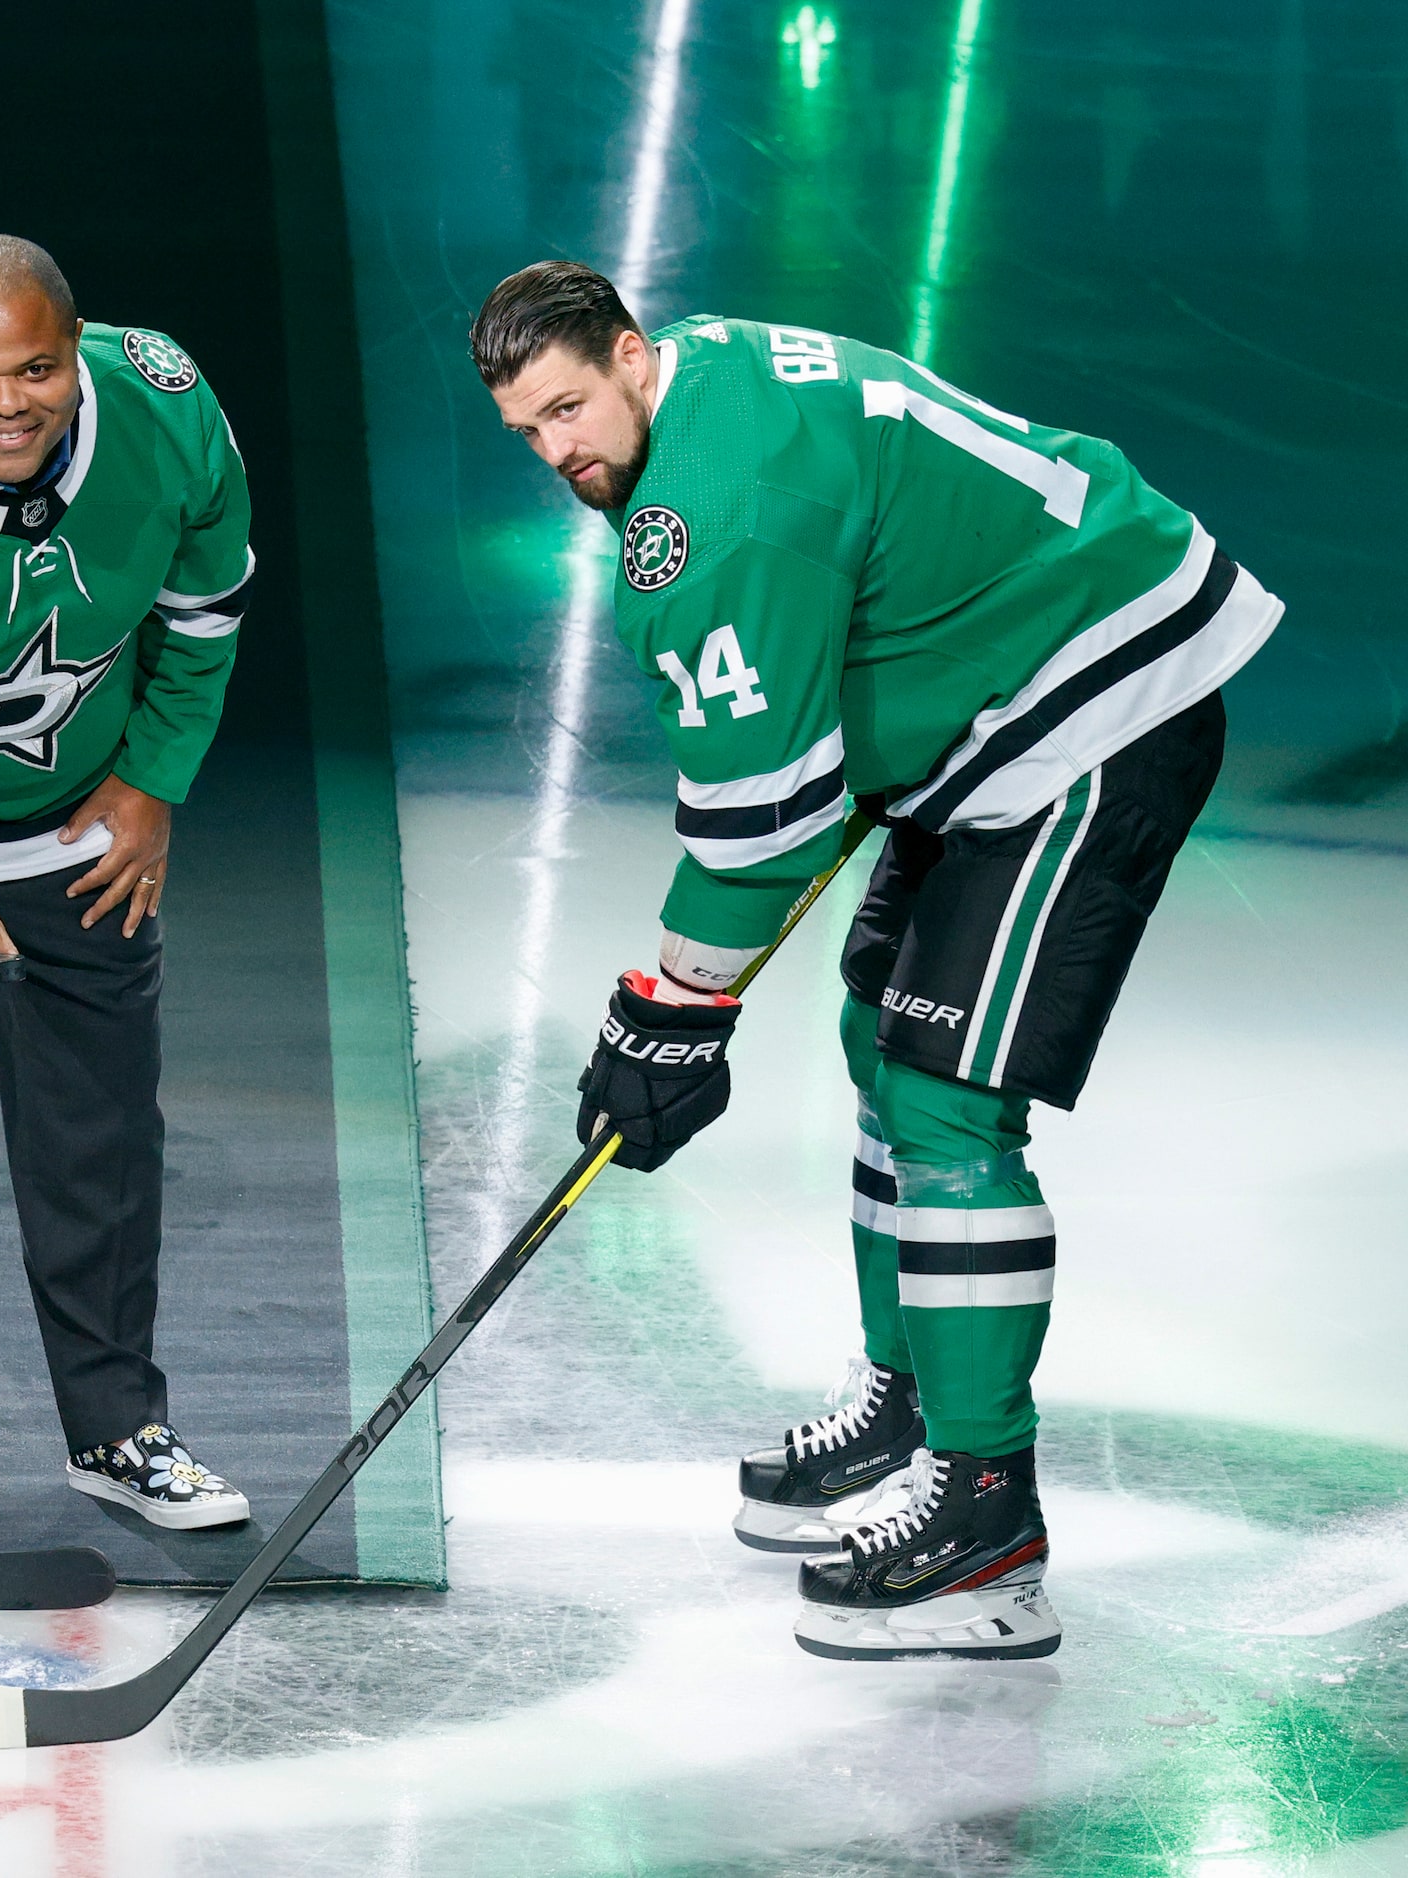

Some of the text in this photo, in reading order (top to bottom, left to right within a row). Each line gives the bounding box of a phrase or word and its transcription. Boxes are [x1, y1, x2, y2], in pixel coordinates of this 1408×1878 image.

[862, 350, 1090, 529] 1
[626, 512, 678, 559] DALLAS
[632, 546, 683, 585] STARS
[656, 624, 769, 728] 14
